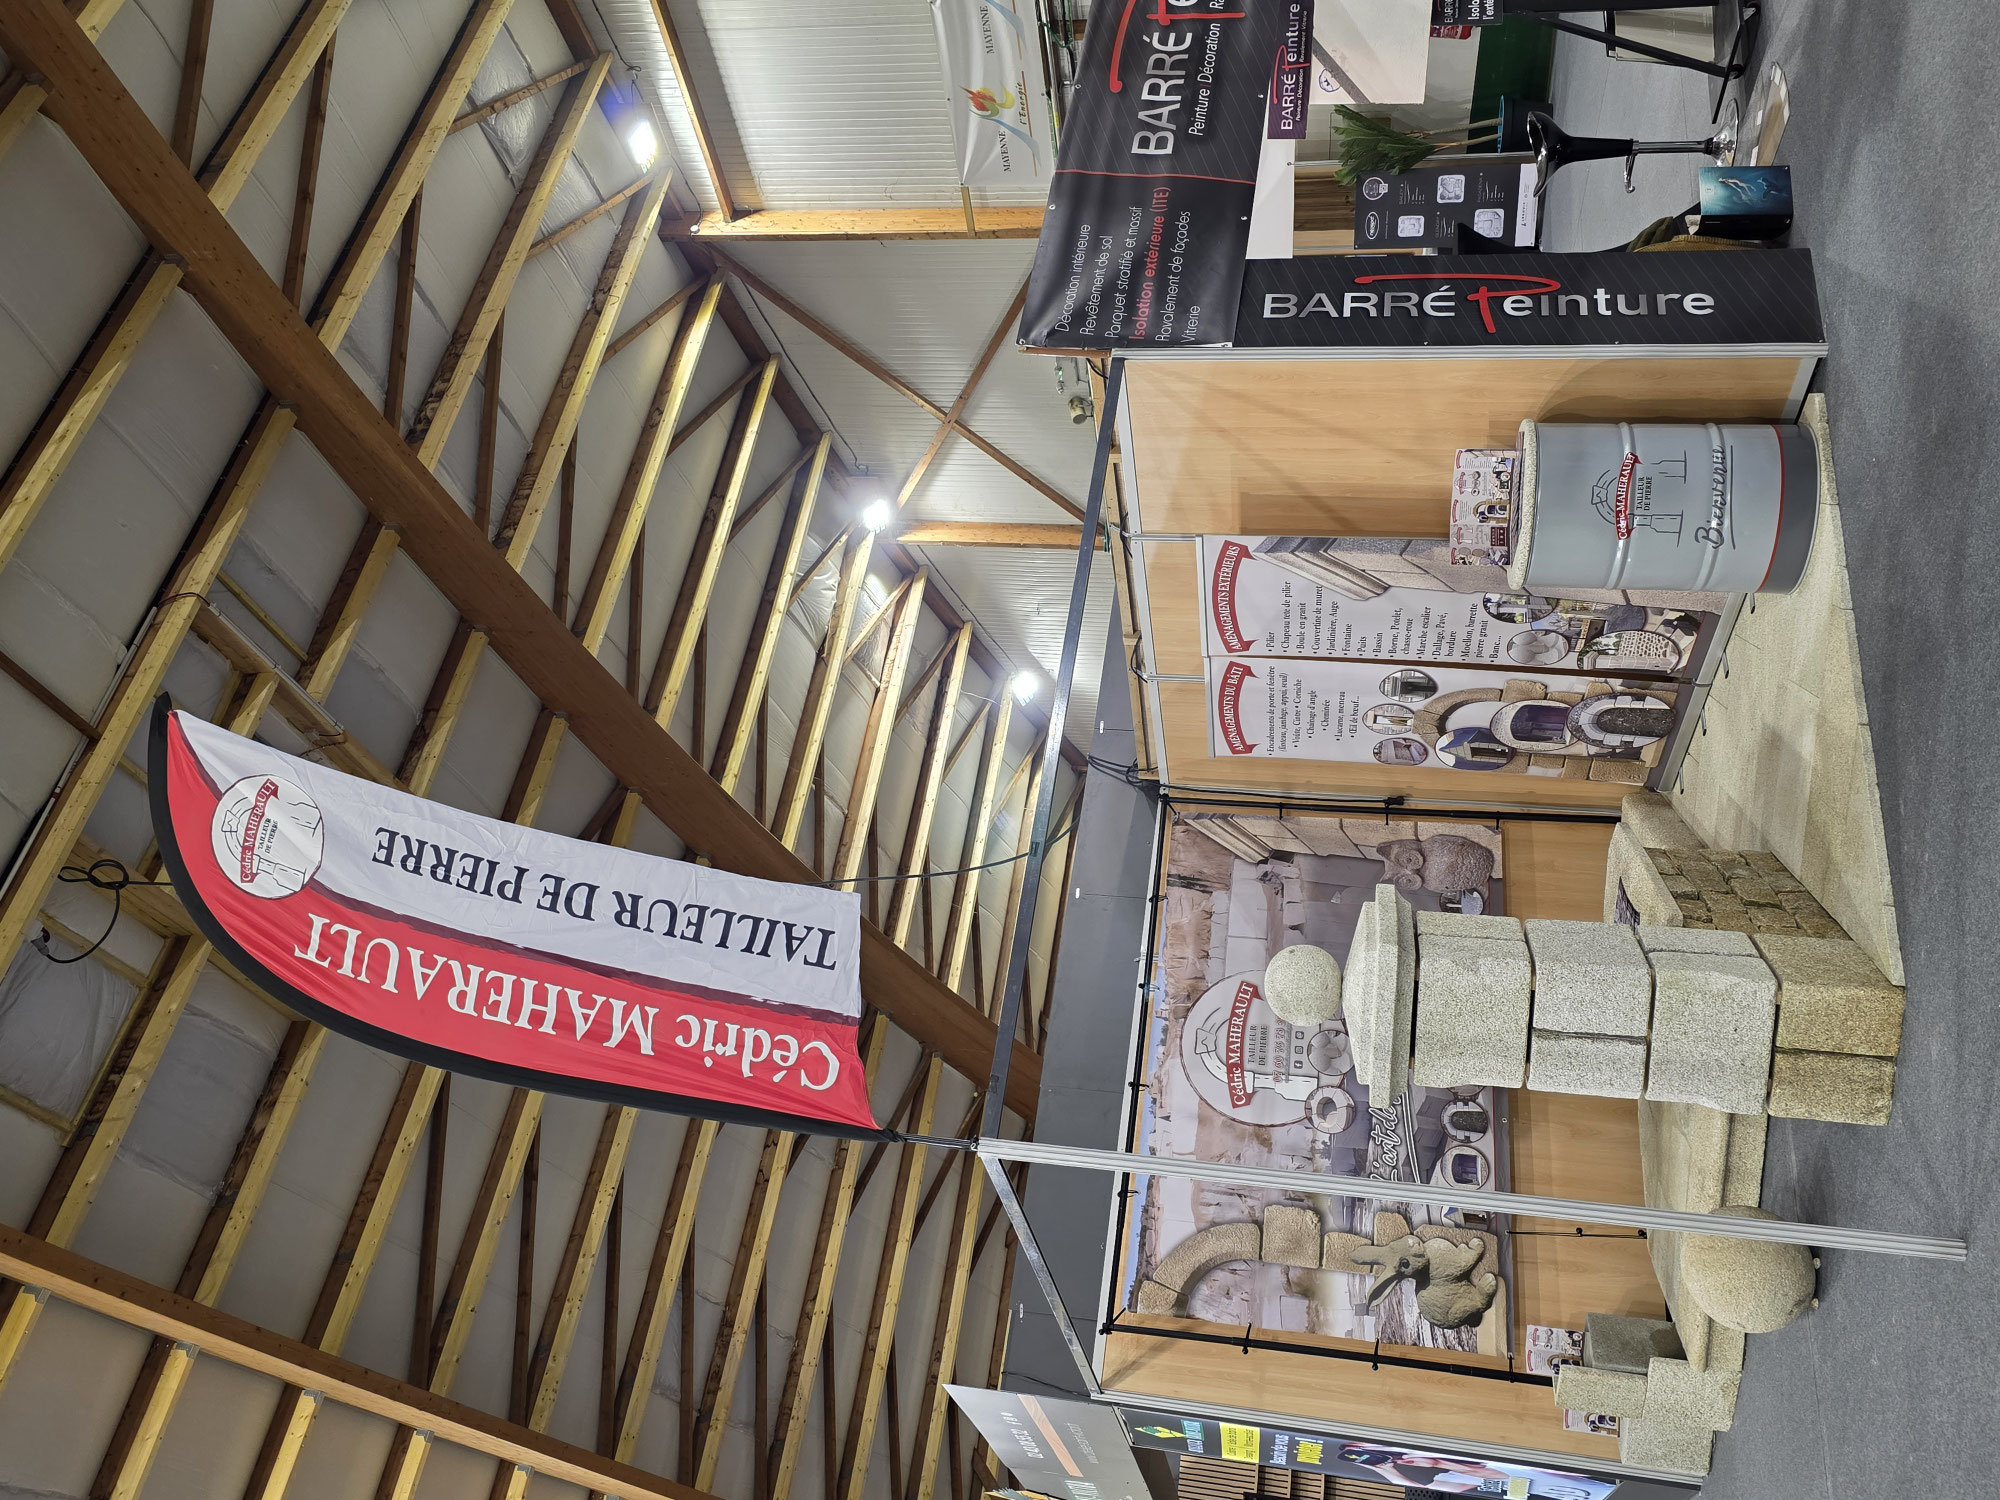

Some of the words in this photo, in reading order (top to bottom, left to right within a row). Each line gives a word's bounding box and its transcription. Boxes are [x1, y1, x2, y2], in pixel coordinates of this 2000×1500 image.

[980, 5, 995, 54] MAYENNE
[1197, 23, 1221, 83] Décoration
[1273, 4, 1310, 104] Peinture
[1130, 32, 1193, 154] BARRÉ
[1281, 74, 1296, 129] BARRÉ
[1188, 88, 1211, 136] Peinture
[998, 131, 1012, 172] MAYENNE
[1152, 186, 1171, 212] (ITE)
[1124, 206, 1143, 235] massif
[1169, 210, 1191, 253] façades
[1098, 235, 1113, 250] sol
[1120, 237, 1137, 247] et
[1140, 215, 1165, 277] extérieure
[1095, 252, 1110, 266] de
[1112, 250, 1133, 290] stratifié
[1165, 256, 1183, 273] de
[1054, 275, 1081, 332] Décoration
[1070, 224, 1091, 272] intérieure
[1080, 268, 1107, 336] Revêtement
[1105, 292, 1132, 338] Parquet
[1129, 282, 1154, 340] Isolation
[1155, 275, 1182, 341] Ravalement
[1262, 285, 1456, 318] BARRÉ
[1180, 305, 1201, 342] Vitrerie
[1617, 452, 1635, 511] MAHERAULT
[1636, 477, 1645, 510] TAILLEUR
[1644, 476, 1652, 500] PIERRE
[1644, 501, 1650, 511] DE
[1694, 445, 1727, 549] Bienvenue
[1617, 512, 1628, 539] Cédric
[1218, 545, 1240, 591] EXTÉRIEURS
[1282, 581, 1292, 599] pilier
[1314, 585, 1322, 606] muret
[1282, 600, 1291, 609] de
[1298, 603, 1308, 620] granit
[1329, 601, 1339, 617] Auge
[1419, 607, 1431, 628] escalier
[1464, 603, 1478, 627] barrette
[1218, 591, 1242, 650] AMÉNAGEMENTS
[1299, 621, 1306, 629] en
[1312, 615, 1321, 650] Couvertine
[1391, 608, 1403, 630] Potelet,
[1436, 612, 1448, 629] Pavé,
[1476, 620, 1489, 637] granit
[1266, 632, 1275, 648] Pilier
[1281, 621, 1291, 649] Chapeau
[1297, 631, 1305, 649] Boule
[1327, 619, 1337, 651] Jardinière,
[1342, 624, 1352, 651] Fontaine
[1357, 636, 1367, 653] Puits
[1373, 633, 1383, 653] Bassin
[1389, 631, 1400, 654] Borne,
[1402, 618, 1413, 654] chasse-roue
[1417, 629, 1428, 656] Marche
[1432, 630, 1445, 656] Dallage,
[1445, 631, 1457, 657] bordure
[1461, 628, 1474, 658] Moellon,
[1474, 639, 1486, 658] pierre
[1489, 635, 1502, 659] Banc...
[1226, 666, 1243, 684] BÂTI
[1266, 666, 1275, 686] fenêtre
[1225, 685, 1236, 696] DU
[1268, 693, 1277, 708] porte
[1293, 679, 1302, 704] Corniche
[1307, 690, 1317, 710] d'angle
[1338, 691, 1346, 714] meneau
[1223, 696, 1244, 751] AMÉNAGEMENTS
[1293, 710, 1301, 726] Cintre
[1307, 711, 1316, 734] Chaînage
[1321, 700, 1331, 727] Cheminée
[1335, 715, 1344, 737] Lucarne,
[1267, 716, 1275, 752] Encadrements
[1293, 727, 1302, 743] Voûte,
[245, 780, 275, 847] MAHERAULT
[258, 818, 271, 849] TAILLEUR
[268, 820, 279, 843] PIERRE
[265, 845, 272, 854] DE
[242, 850, 252, 880] Cédric
[372, 826, 531, 905] PIERRE
[539, 874, 601, 921] DE
[610, 889, 837, 971] TAILLEUR
[293, 912, 660, 1056] MAHERAULT
[1229, 983, 1253, 1064] MAHERAULT
[674, 1013, 841, 1091] Cédric
[1248, 1025, 1256, 1064] TAILLEUR
[1259, 1025, 1268, 1053] PIERRE
[1259, 1055, 1266, 1066] DE
[1230, 1067, 1246, 1105] Cédric
[1273, 1071, 1283, 1082] 07
[1274, 1434, 1289, 1445] vous
